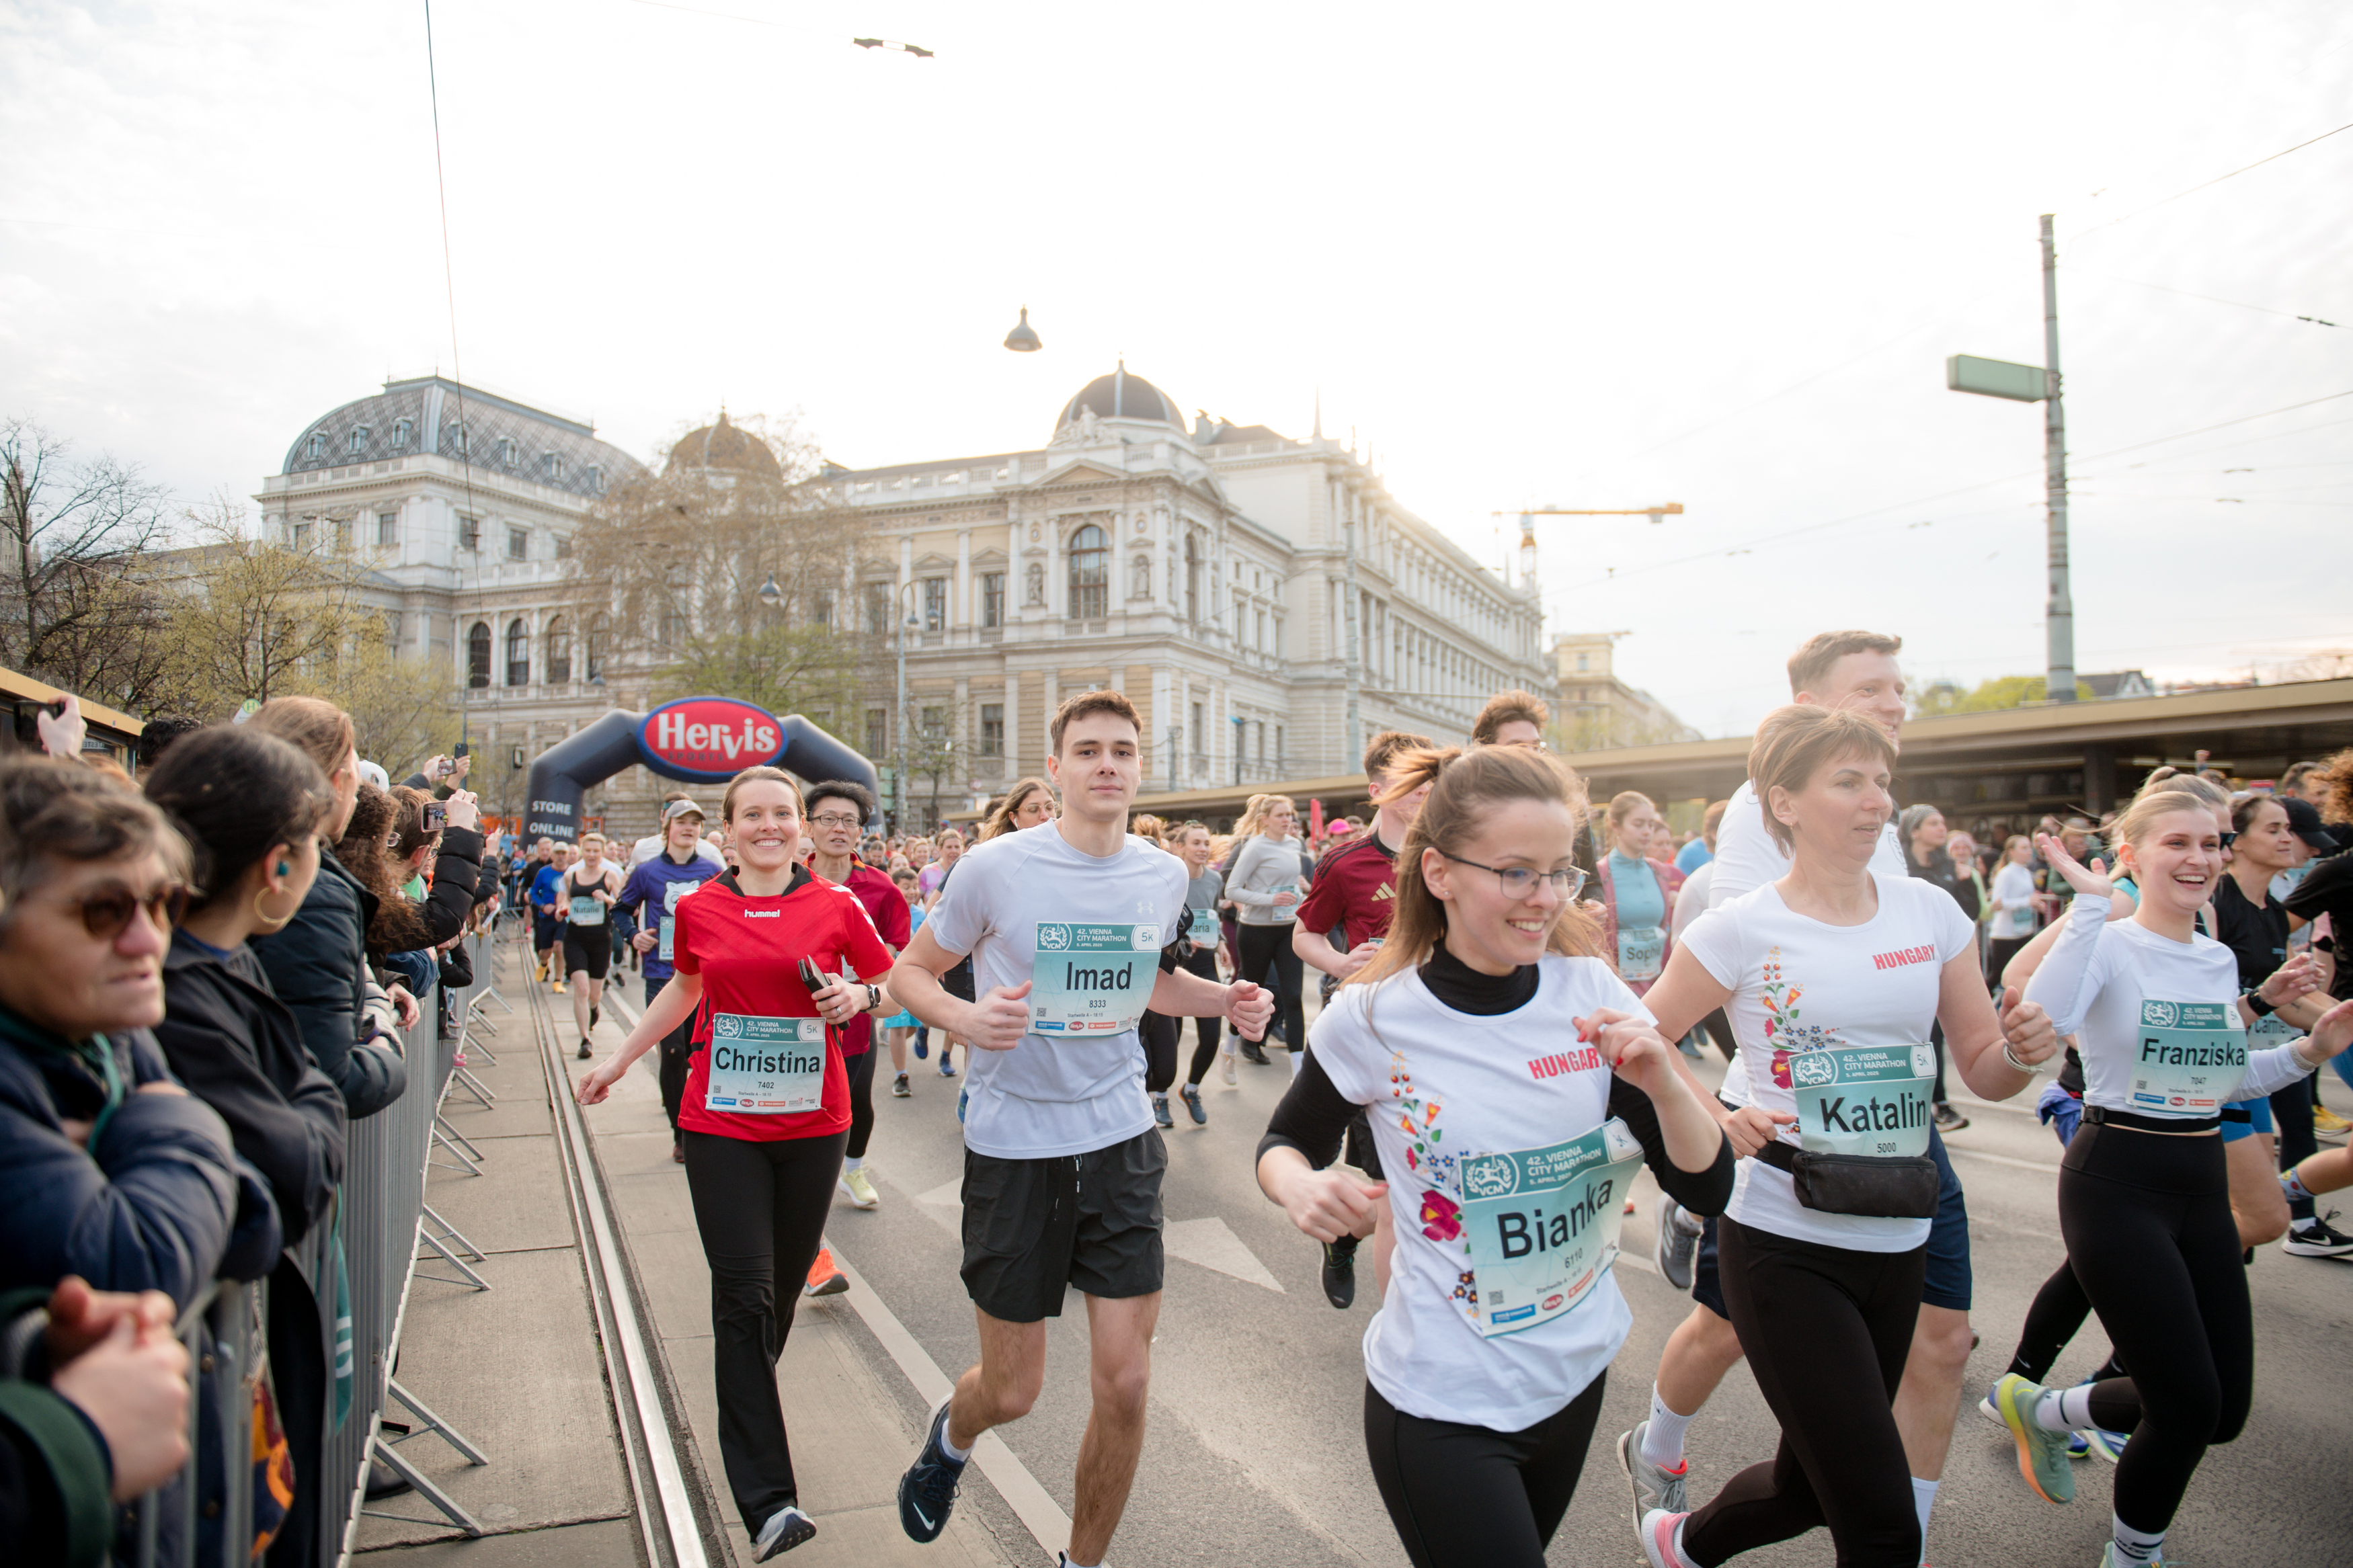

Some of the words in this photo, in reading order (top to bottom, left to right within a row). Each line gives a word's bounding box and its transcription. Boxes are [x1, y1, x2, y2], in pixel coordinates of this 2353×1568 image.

[247, 702, 255, 711] H
[658, 712, 776, 759] Hervis
[668, 752, 723, 761] SPORTS
[532, 800, 573, 815] STORE
[529, 822, 575, 838] ONLINE
[863, 824, 883, 836] LINE
[744, 909, 781, 917] hummel
[1142, 932, 1153, 942] 5K
[1872, 944, 1935, 970] HUNGARY
[1066, 962, 1132, 991] Imad
[1089, 1000, 1106, 1008] 8333
[807, 1025, 817, 1034] 5K
[1857, 1053, 1888, 1061] VIENNA
[2141, 1038, 2245, 1066] Franziska
[715, 1046, 820, 1074] Christina
[1527, 1048, 1607, 1079] HUNGAR
[1864, 1060, 1907, 1069] MARATHON
[1917, 1054, 1929, 1066] 5K
[758, 1081, 774, 1089] 7402
[1806, 1076, 1827, 1085] VCM
[2191, 1077, 2206, 1085] 7047
[1820, 1092, 1926, 1132] Katalin
[1877, 1143, 1896, 1153] 5000
[1527, 1156, 1544, 1165] 42.
[1546, 1146, 1583, 1163] VIENNA
[1528, 1165, 1552, 1176] CITY
[1554, 1148, 1601, 1173] MARATHON
[1538, 1175, 1556, 1184] APRIL
[1480, 1185, 1504, 1196] VCM
[1497, 1180, 1613, 1260] Bianka
[1564, 1248, 1583, 1268] 6110
